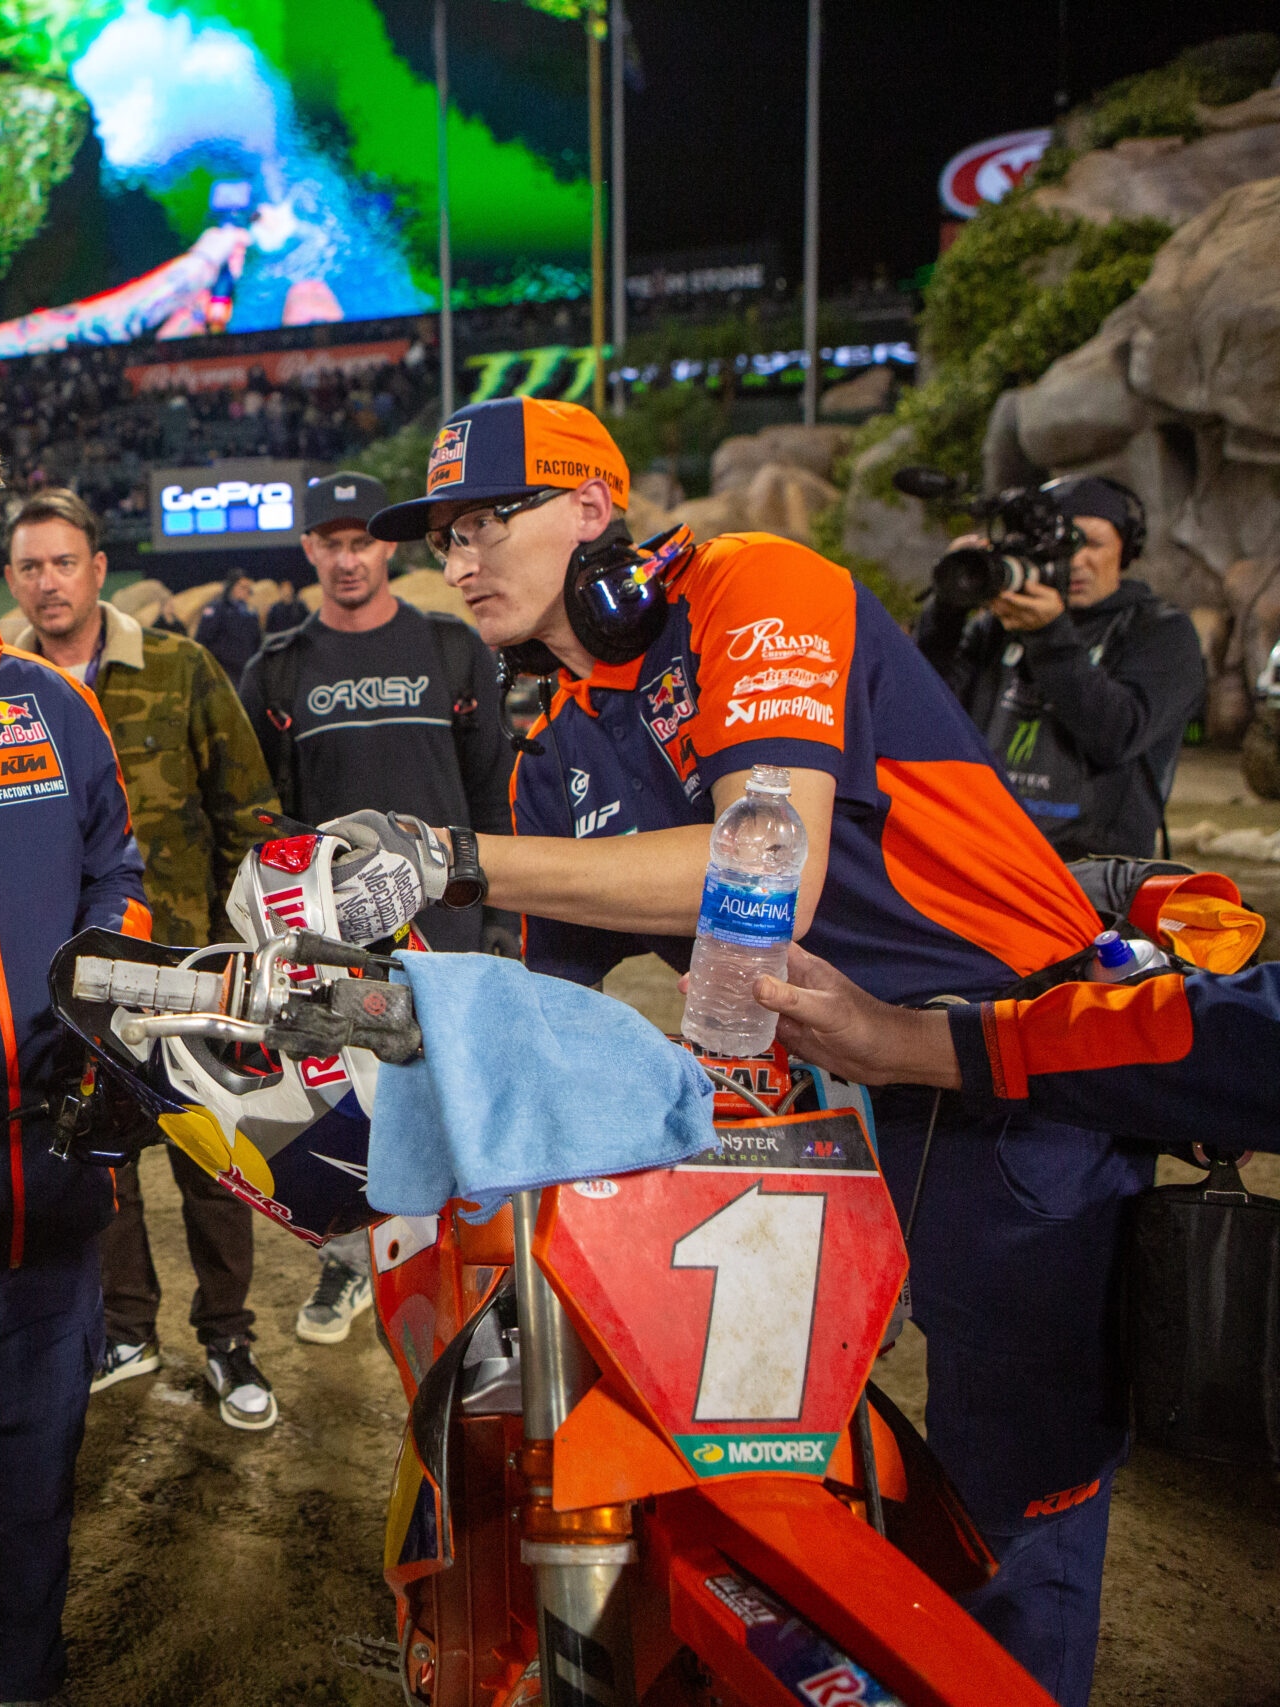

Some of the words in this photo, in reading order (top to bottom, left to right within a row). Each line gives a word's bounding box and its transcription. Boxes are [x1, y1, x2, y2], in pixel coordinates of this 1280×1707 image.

[536, 459, 590, 477] FACTORY
[595, 467, 624, 495] RACING
[161, 480, 293, 512] GoPro
[307, 675, 429, 715] OAKLEY
[758, 695, 835, 727] AKRAPOVIC
[12, 721, 47, 743] Bull
[0, 754, 48, 776] KTM
[34, 779, 65, 794] RACING
[575, 800, 621, 839] WP
[719, 895, 789, 920] AQUAFINA
[719, 1134, 780, 1152] NSTER
[801, 1140, 843, 1158] AMA
[707, 1153, 768, 1161] ENERGY
[581, 1178, 615, 1195] AMA
[670, 1178, 827, 1424] 1
[728, 1440, 825, 1463] MOTOREX
[1023, 1478, 1100, 1518] KTM
